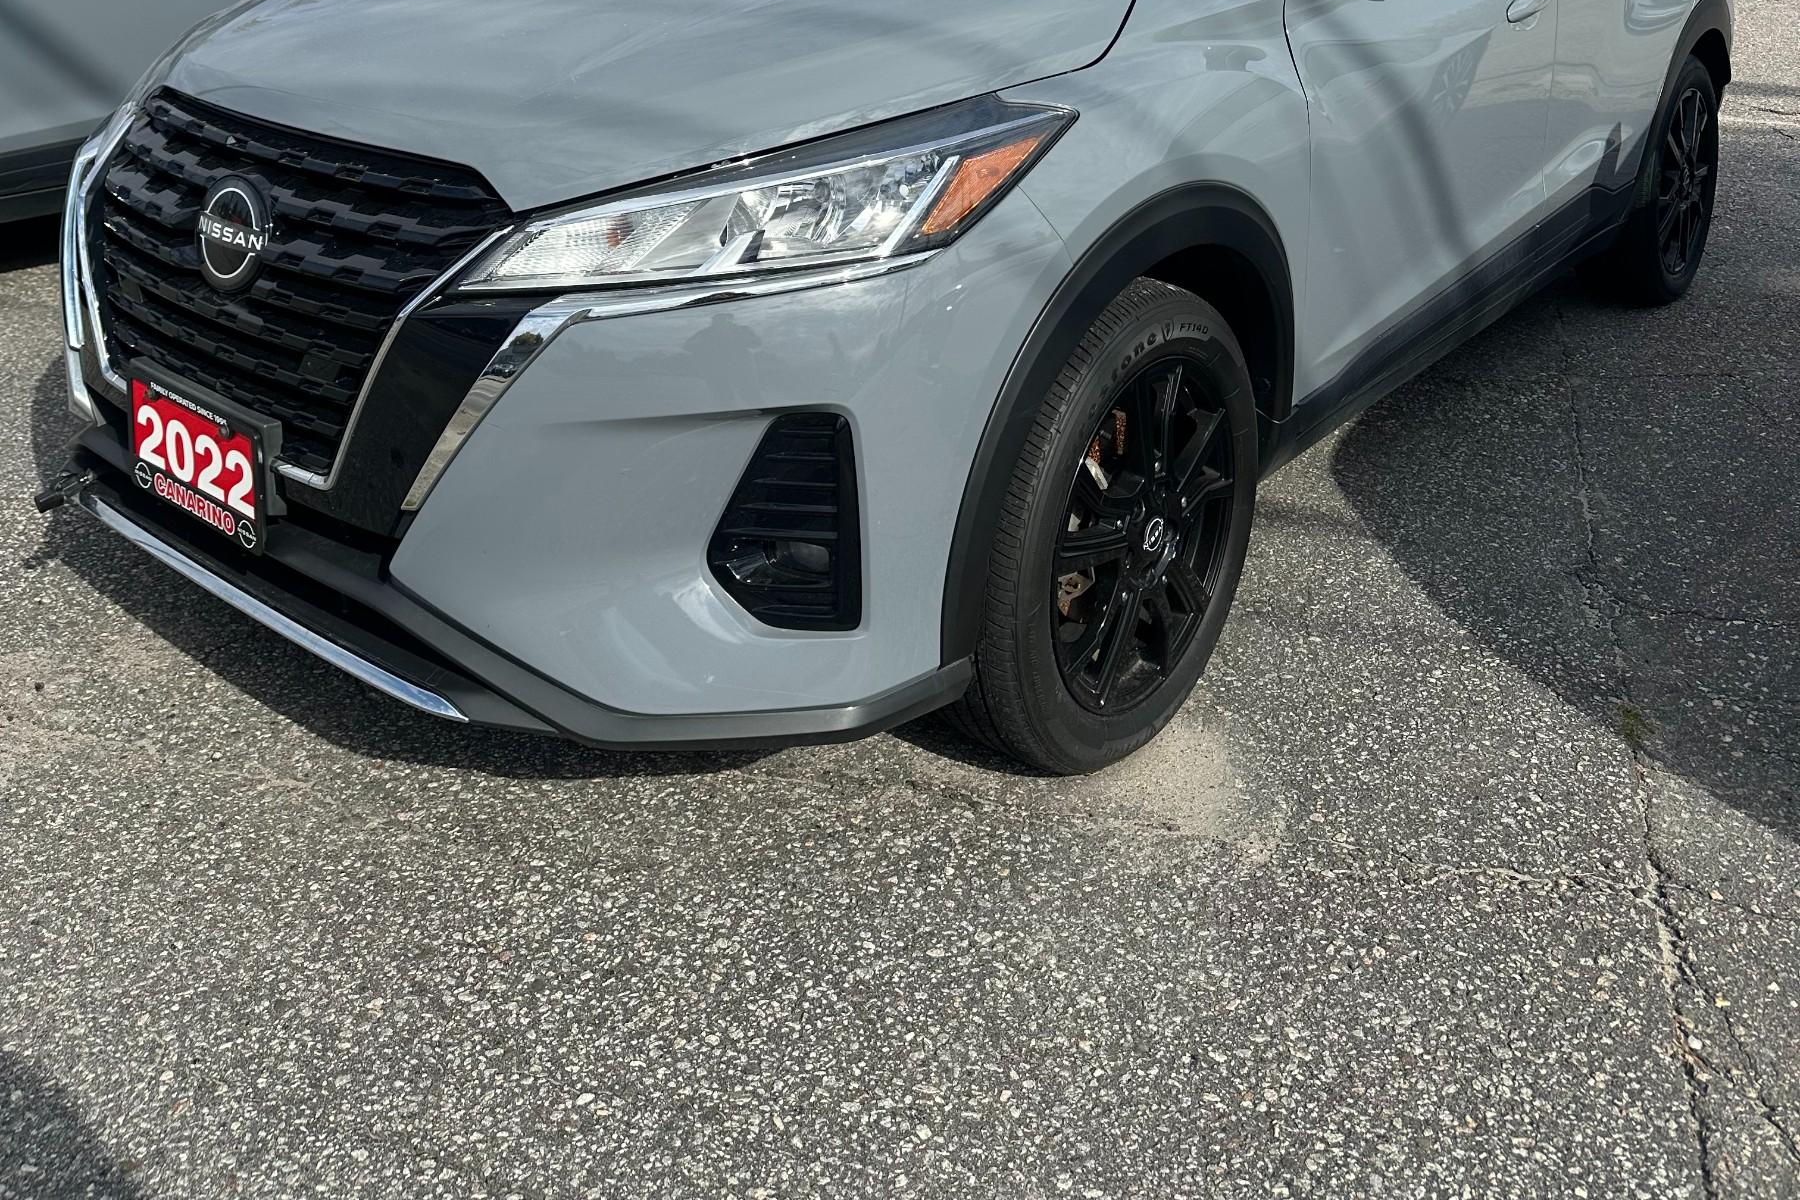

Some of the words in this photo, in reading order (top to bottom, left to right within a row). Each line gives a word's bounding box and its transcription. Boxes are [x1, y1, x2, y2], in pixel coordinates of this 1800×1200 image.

[198, 215, 263, 251] NISSAN
[150, 381, 169, 397] FAMILY
[168, 391, 197, 411] OPERATED
[196, 405, 214, 421] SINCE
[137, 404, 256, 520] 2022
[153, 472, 235, 536] CANARINO
